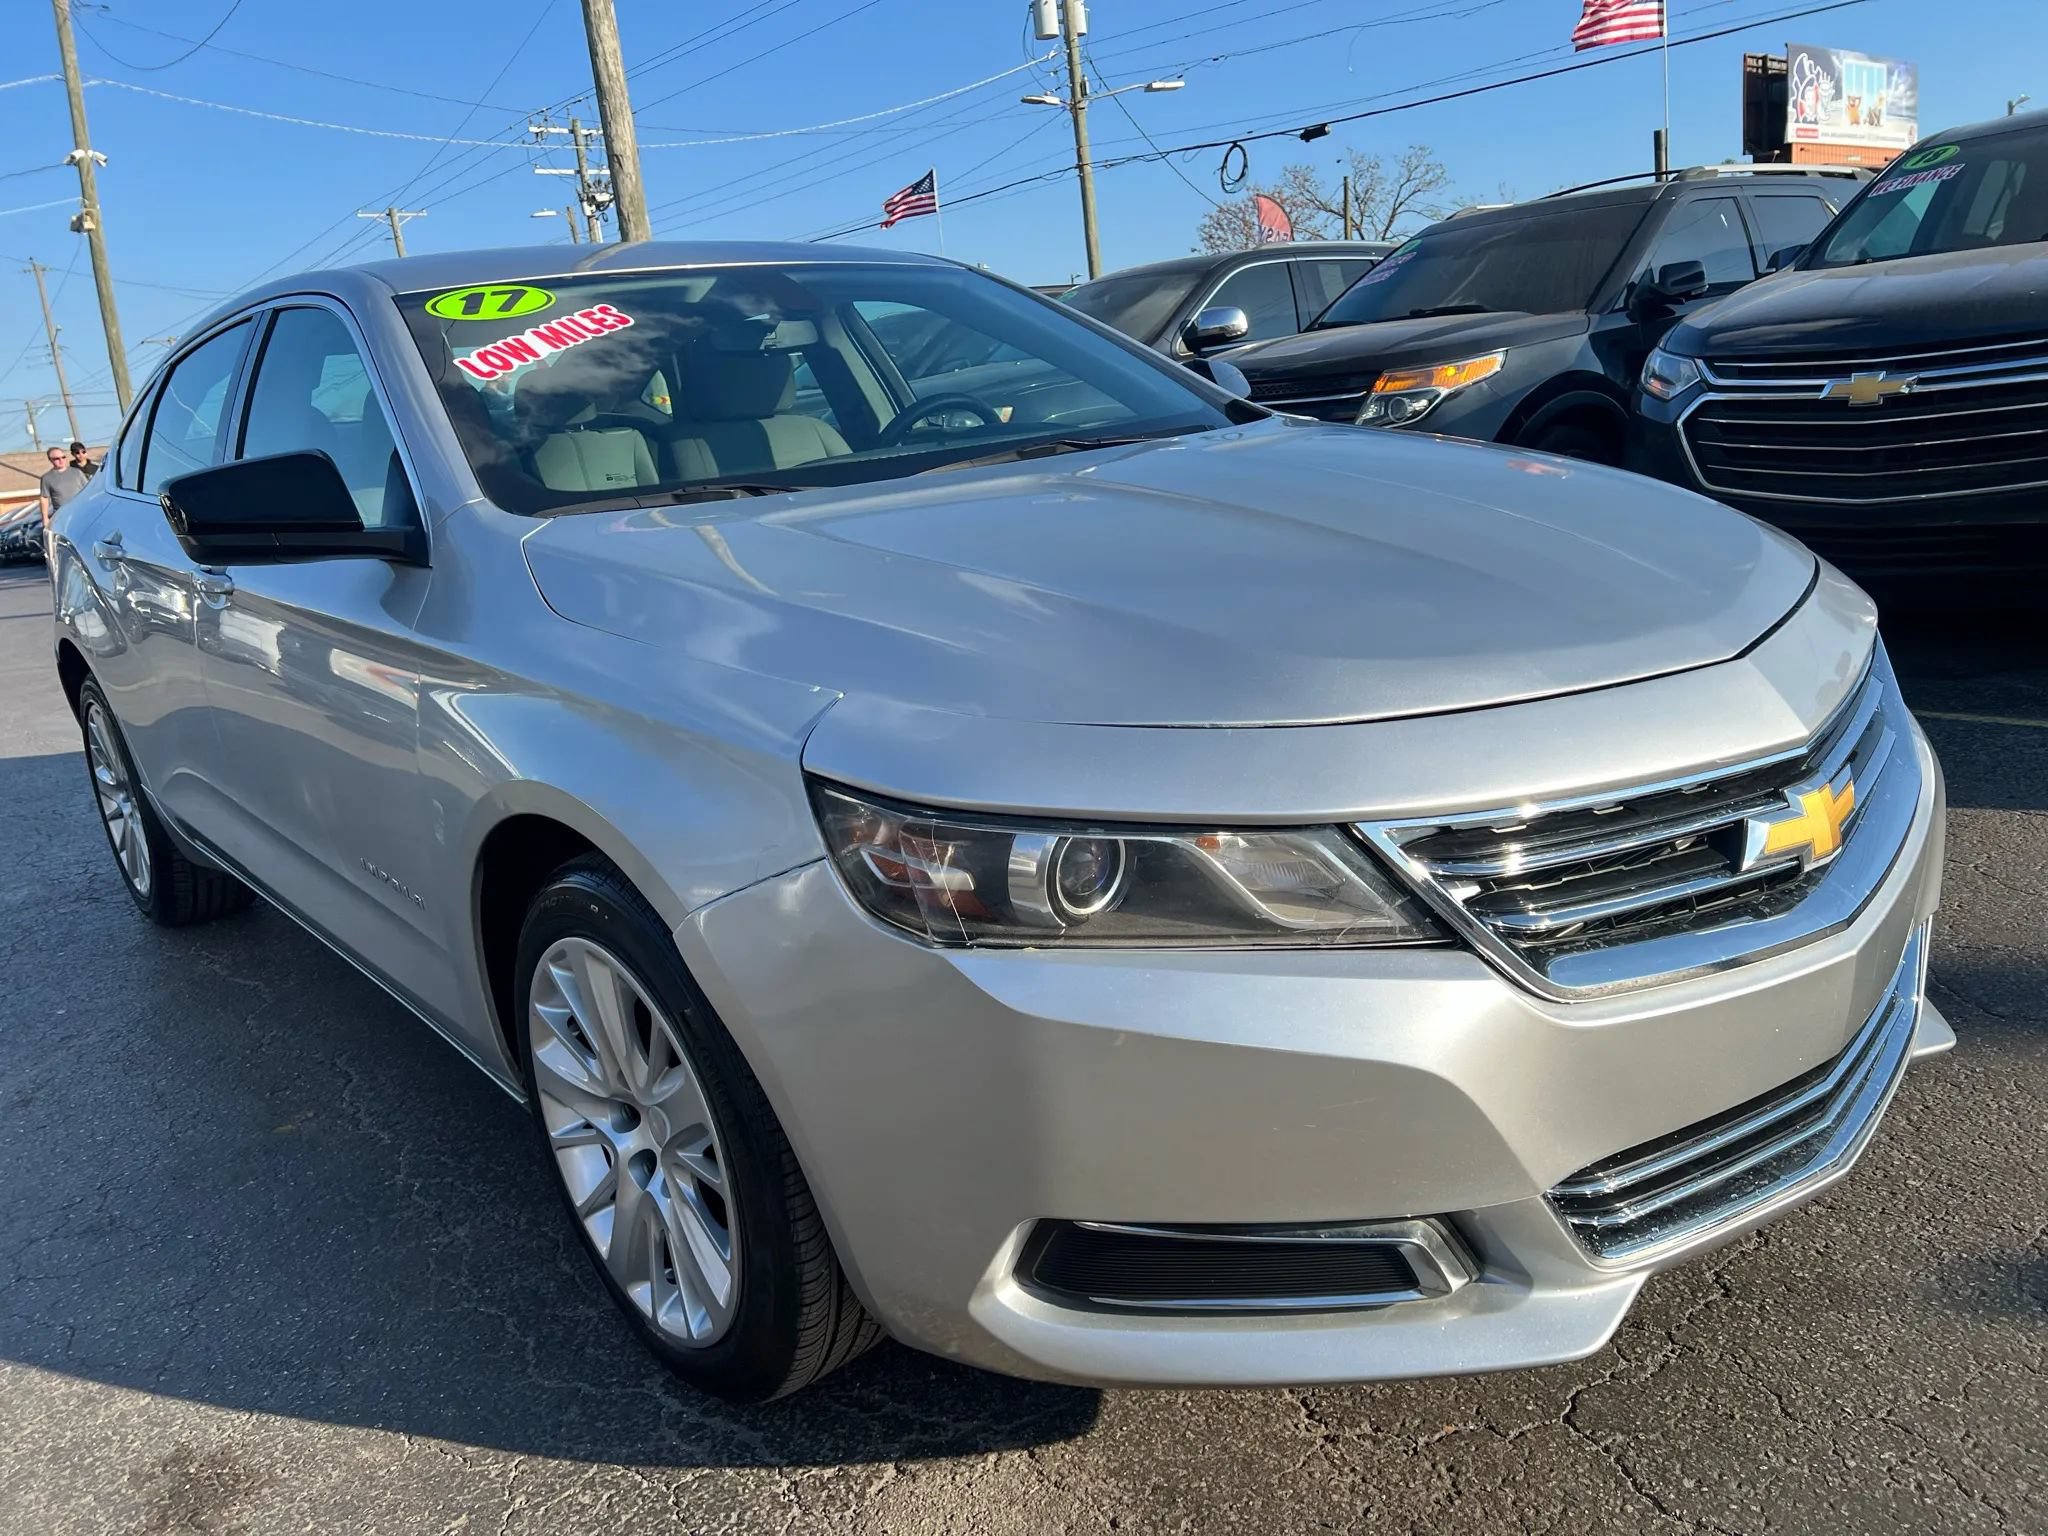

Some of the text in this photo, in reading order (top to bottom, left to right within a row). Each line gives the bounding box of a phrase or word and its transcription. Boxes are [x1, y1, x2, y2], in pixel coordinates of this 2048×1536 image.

[1869, 164, 1965, 197] WE FINANCE
[458, 288, 530, 315] 17
[458, 305, 632, 379] LOW MILES
